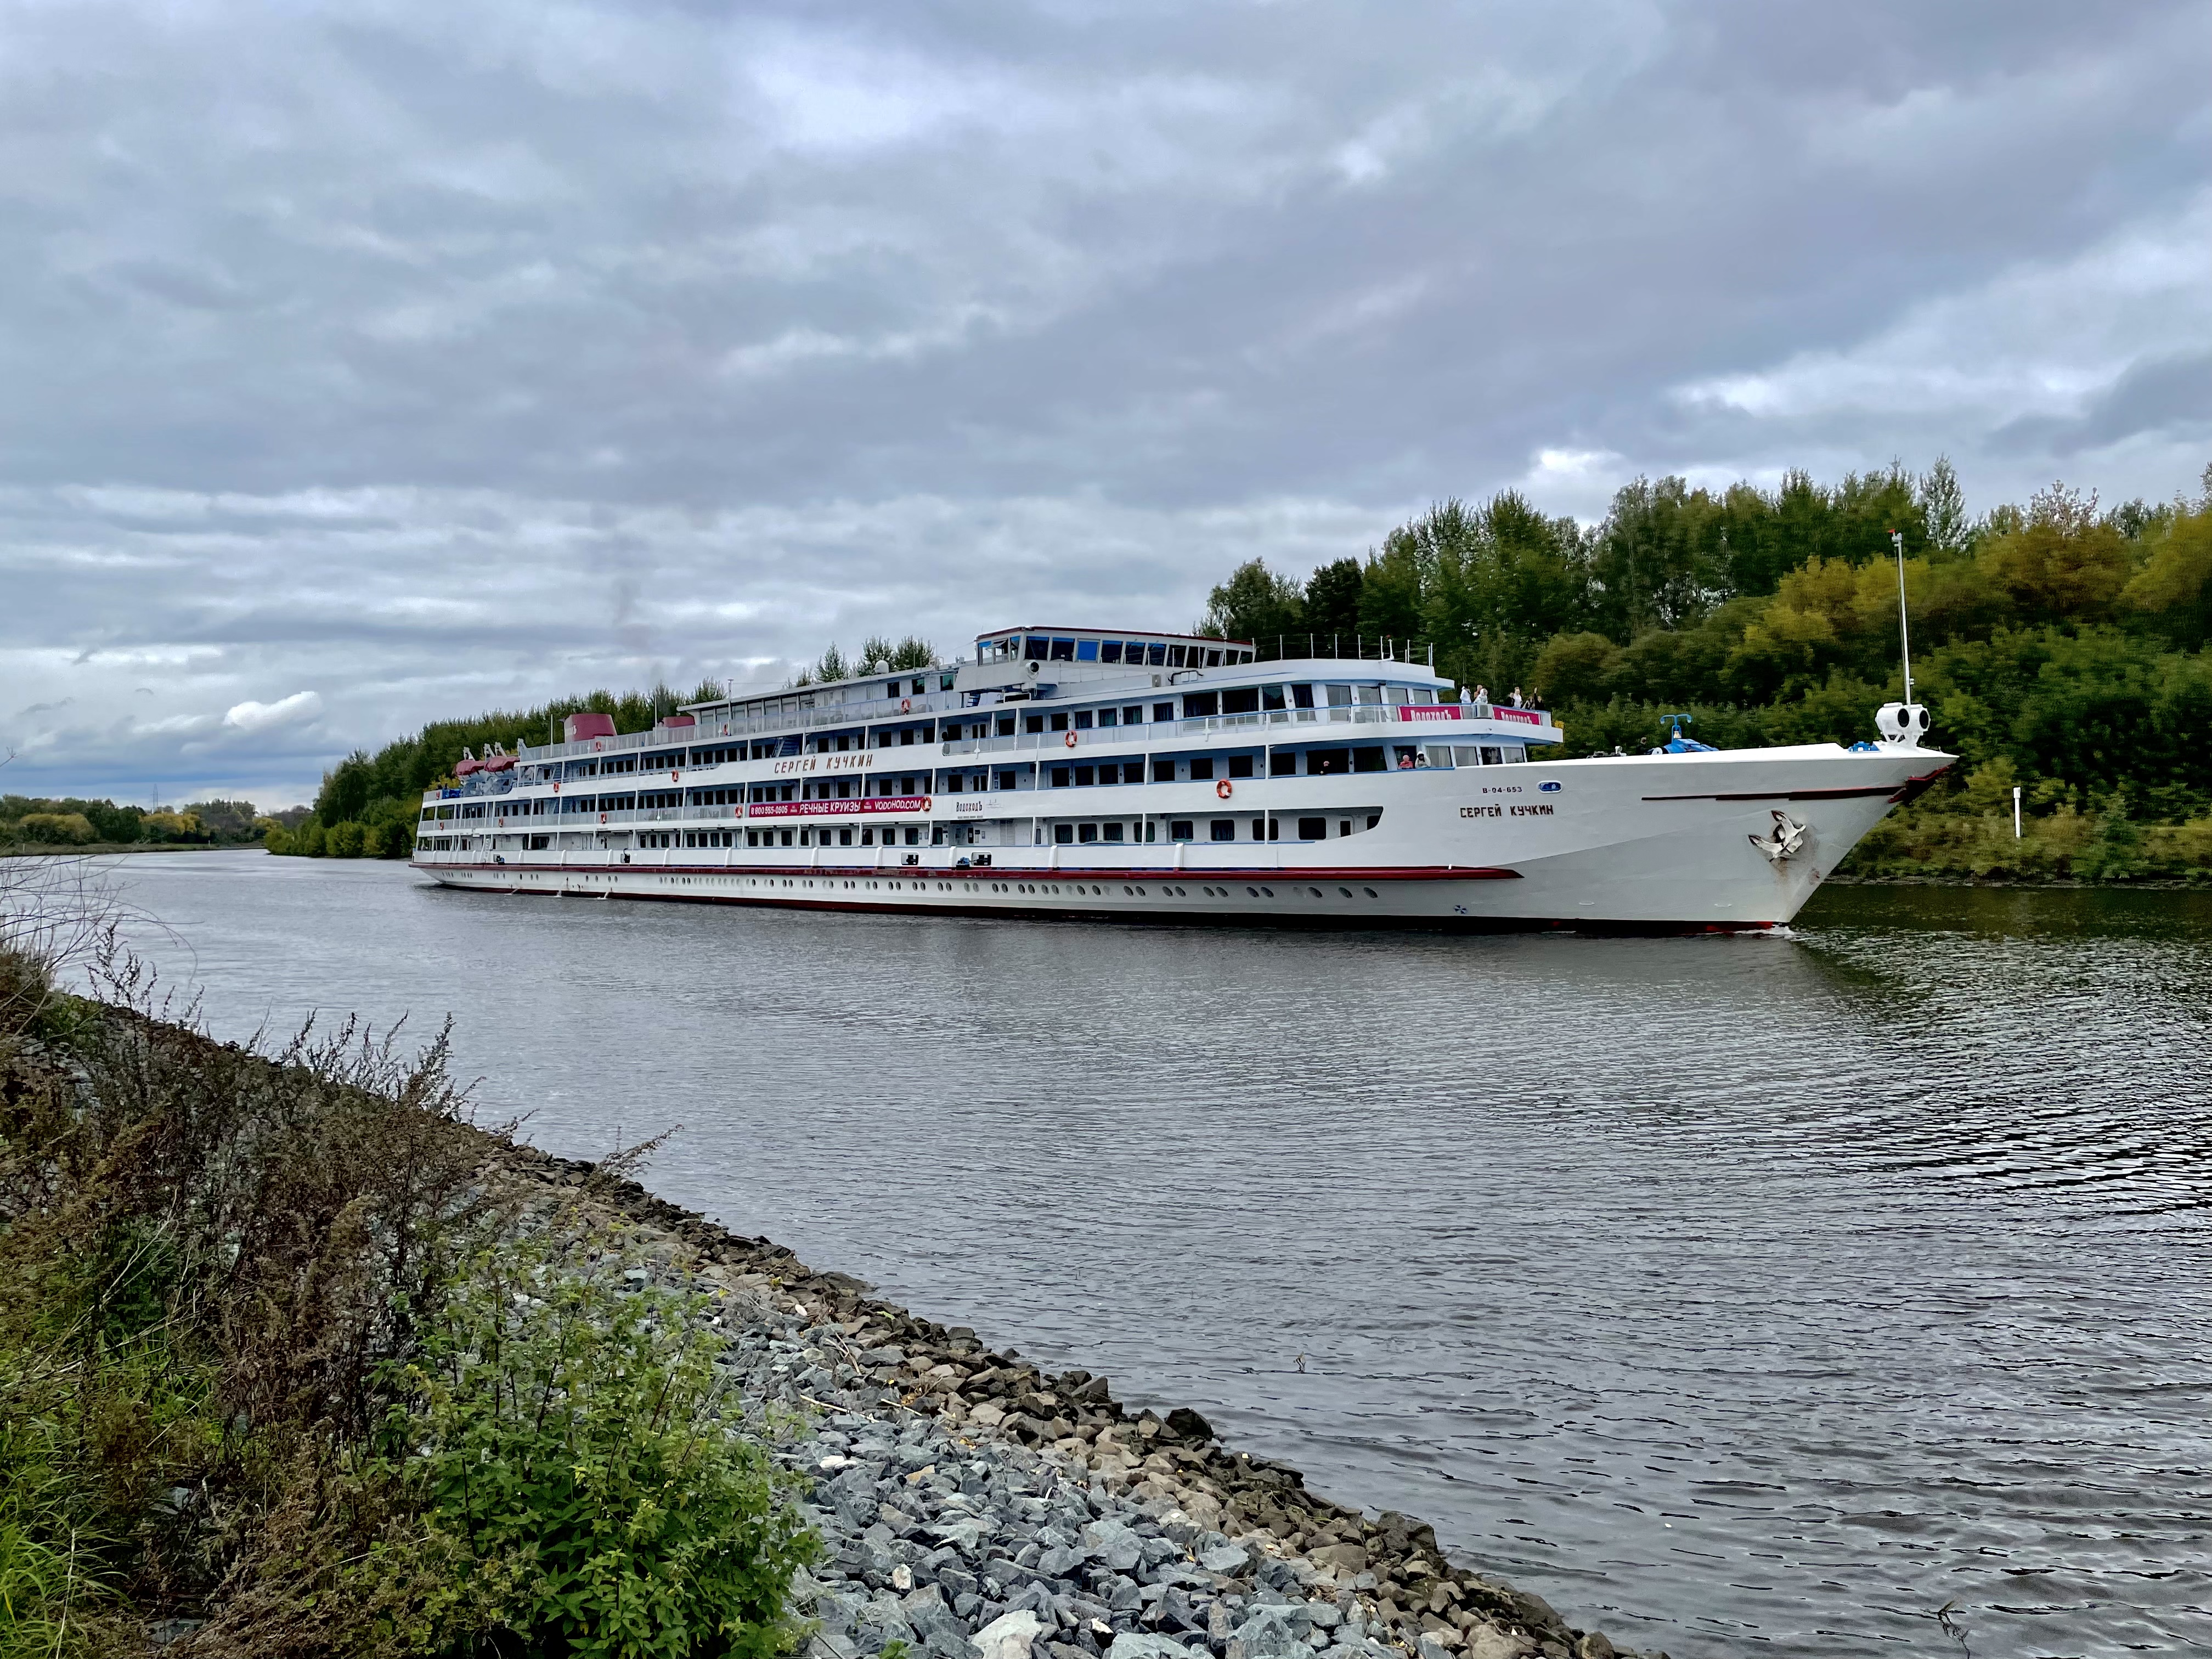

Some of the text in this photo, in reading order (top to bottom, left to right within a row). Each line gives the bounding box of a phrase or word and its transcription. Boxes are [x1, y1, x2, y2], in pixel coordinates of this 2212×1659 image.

[774, 754, 873, 774] СЕРГЕЙ КУЧКИН
[755, 806, 764, 815] 800
[765, 805, 788, 814] 555-0505
[799, 803, 829, 814] РЕЧНЫЕ
[830, 801, 861, 812] КРУИЗЫ
[874, 799, 921, 810] VODOHOD.COM
[1460, 803, 1554, 818] СЕРГЕЙ КУЧКИН
